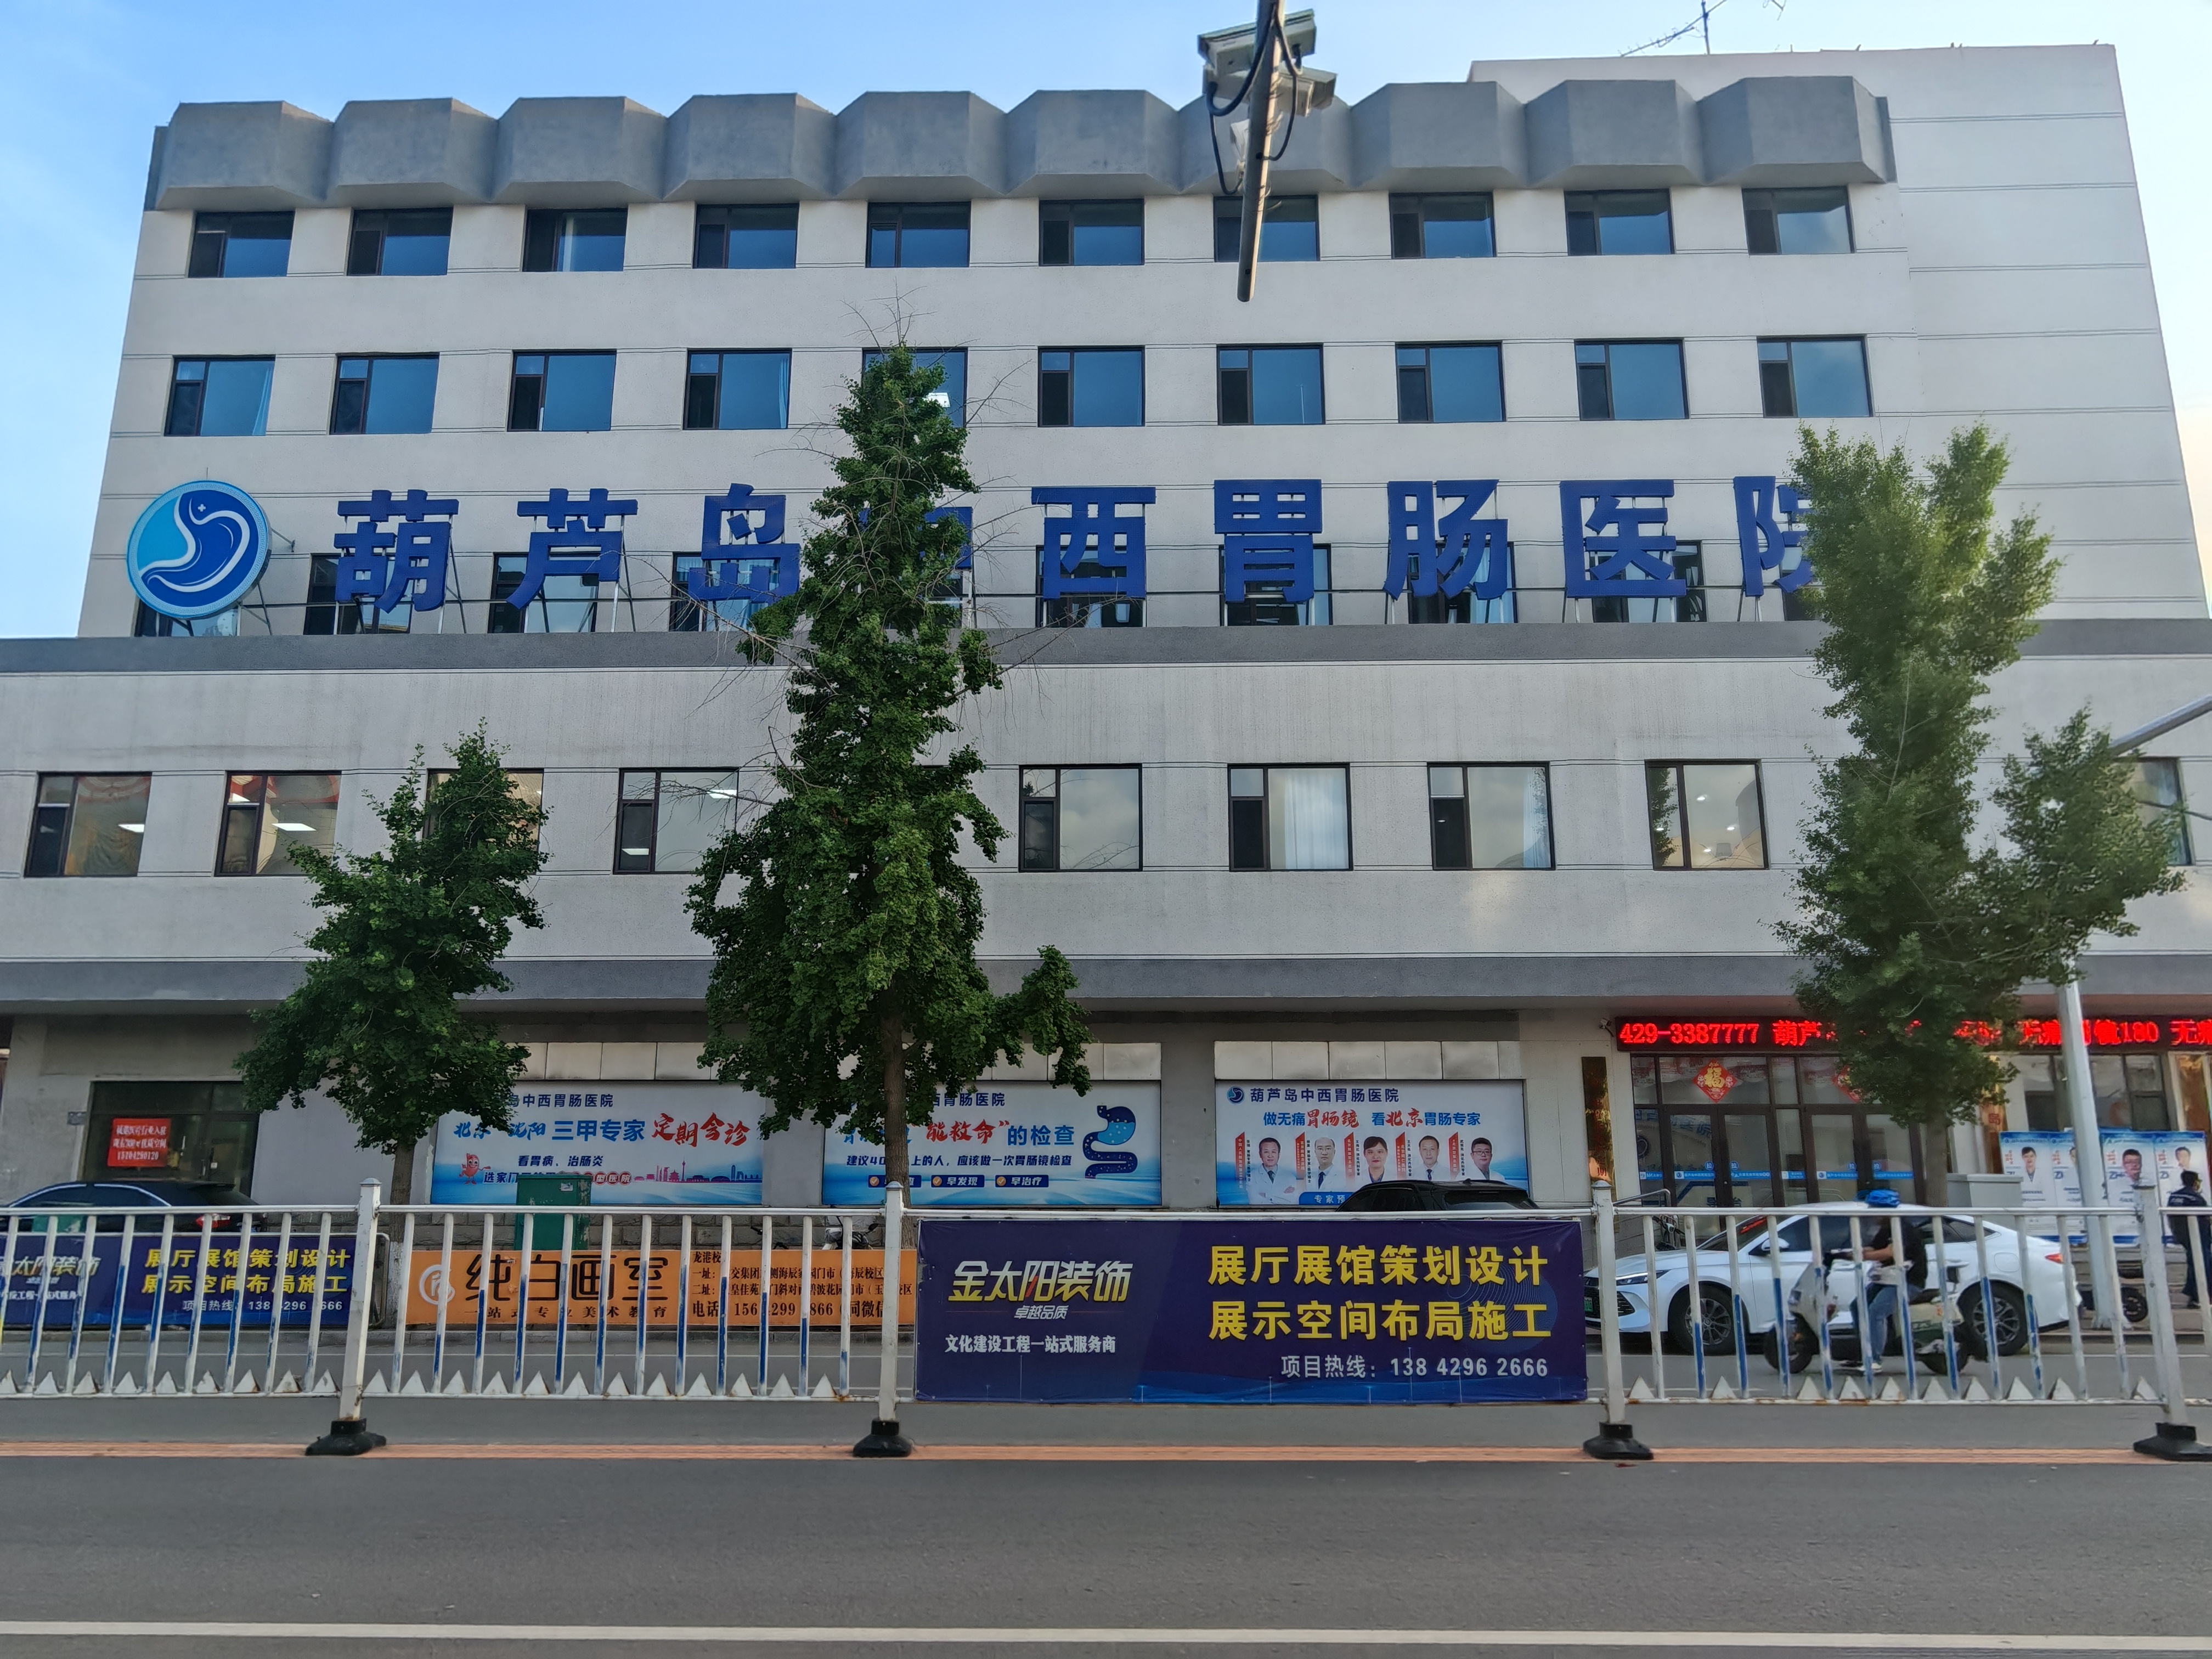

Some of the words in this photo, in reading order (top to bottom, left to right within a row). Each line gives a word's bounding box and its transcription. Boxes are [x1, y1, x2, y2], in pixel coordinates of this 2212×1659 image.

[334, 475, 1815, 612] 葫芦岛西胃肠医院
[1619, 1023, 1759, 1044] 429-3387777
[1250, 1088, 1399, 1103] 葫芦岛中西胃肠医院
[1263, 1108, 1359, 1128] 做无痛胃肠镜
[1372, 1107, 1481, 1128] 看北京胃肠专家
[518, 1155, 603, 1167] 看胃病、治肠炎
[847, 1154, 1072, 1167] 建议40上的人，应该做一次胃肠镜检查
[946, 1177, 978, 1186] 早发现
[1011, 1177, 1042, 1186] 早治疗
[1208, 1245, 1548, 1286] 展厅展馆策划设计
[465, 1254, 669, 1301] 纯白画室
[948, 1261, 1133, 1302] 金太阳装饰
[1014, 1305, 1069, 1319] 卓越品质
[1209, 1300, 1551, 1341] 展示空间布局施工
[944, 1334, 1116, 1353] 文化建设工程一站式服务商
[1281, 1355, 1375, 1378] 项目热线：
[1390, 1358, 1427, 1376] 138
[1437, 1358, 1487, 1376] 4296
[1497, 1358, 1548, 1376] 2666
